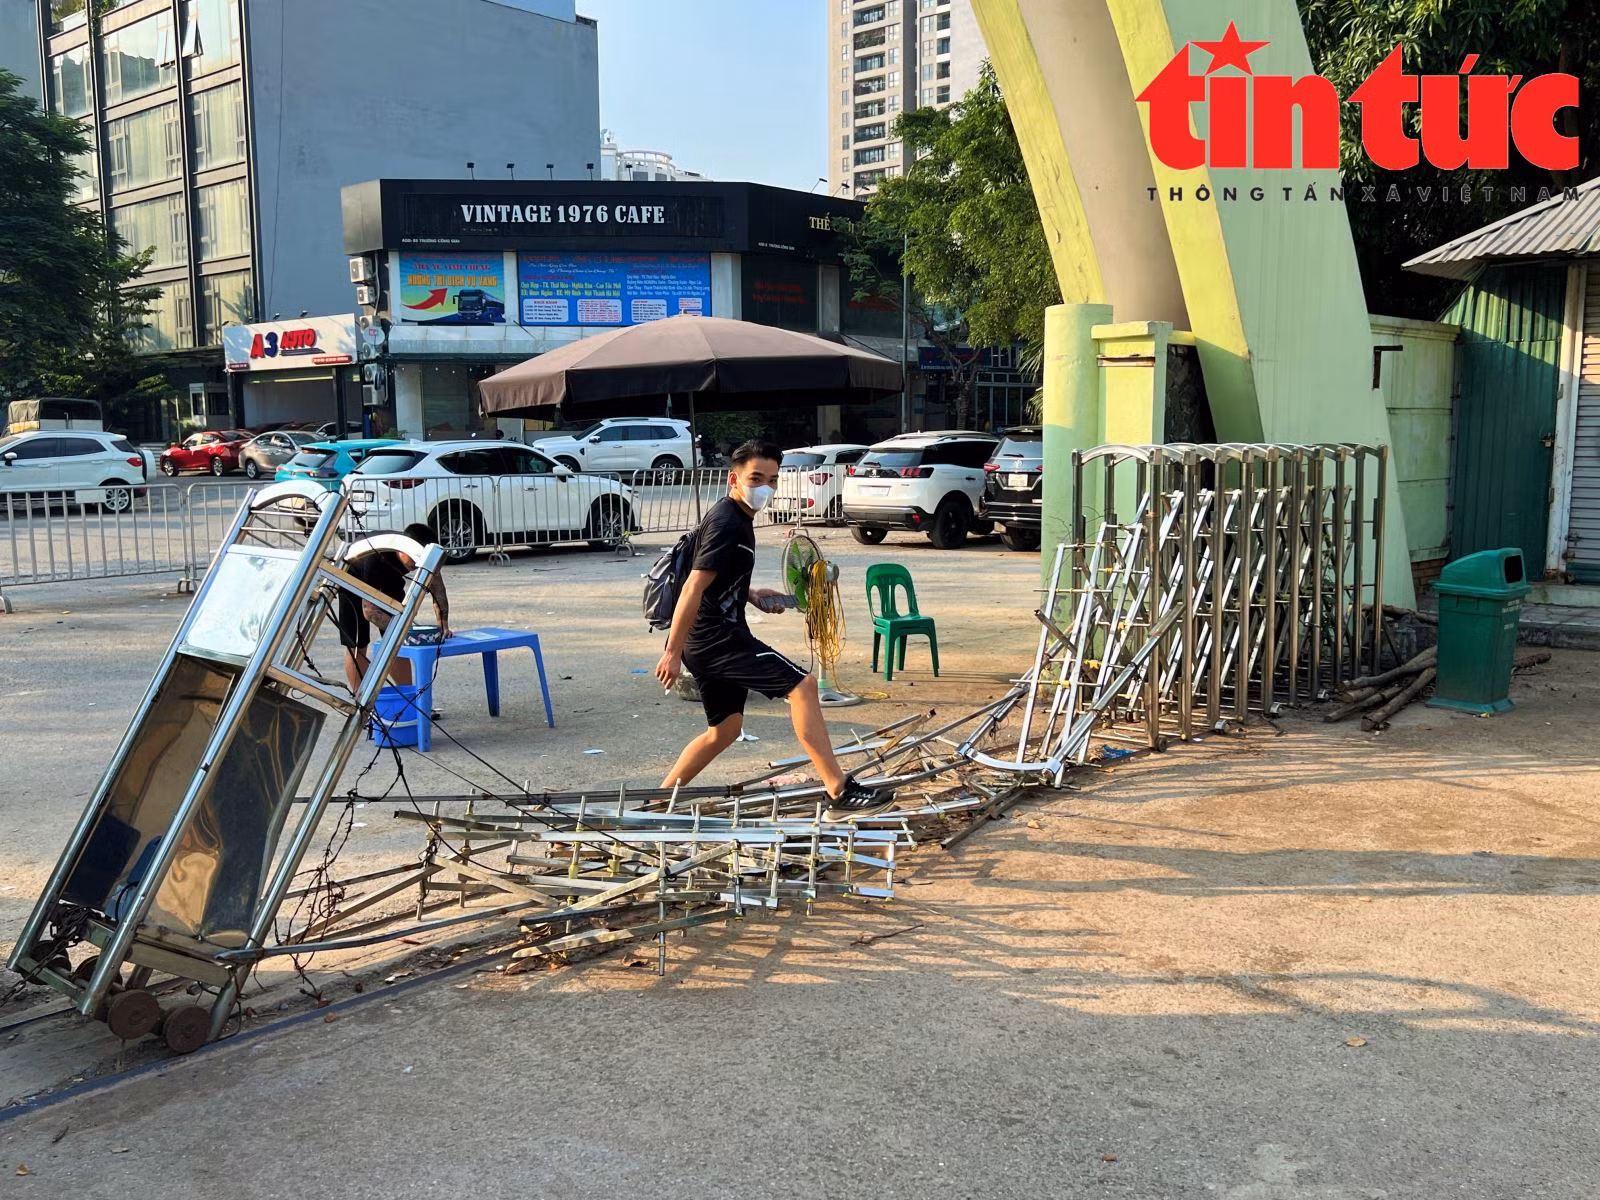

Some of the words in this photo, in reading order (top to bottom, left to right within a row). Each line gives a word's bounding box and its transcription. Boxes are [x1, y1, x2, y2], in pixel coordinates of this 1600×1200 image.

[461, 204, 552, 223] VINTAGE
[557, 205, 609, 223] 1976
[614, 205, 665, 224] CAFE
[250, 331, 279, 359] A3
[280, 328, 317, 349] AUTO
